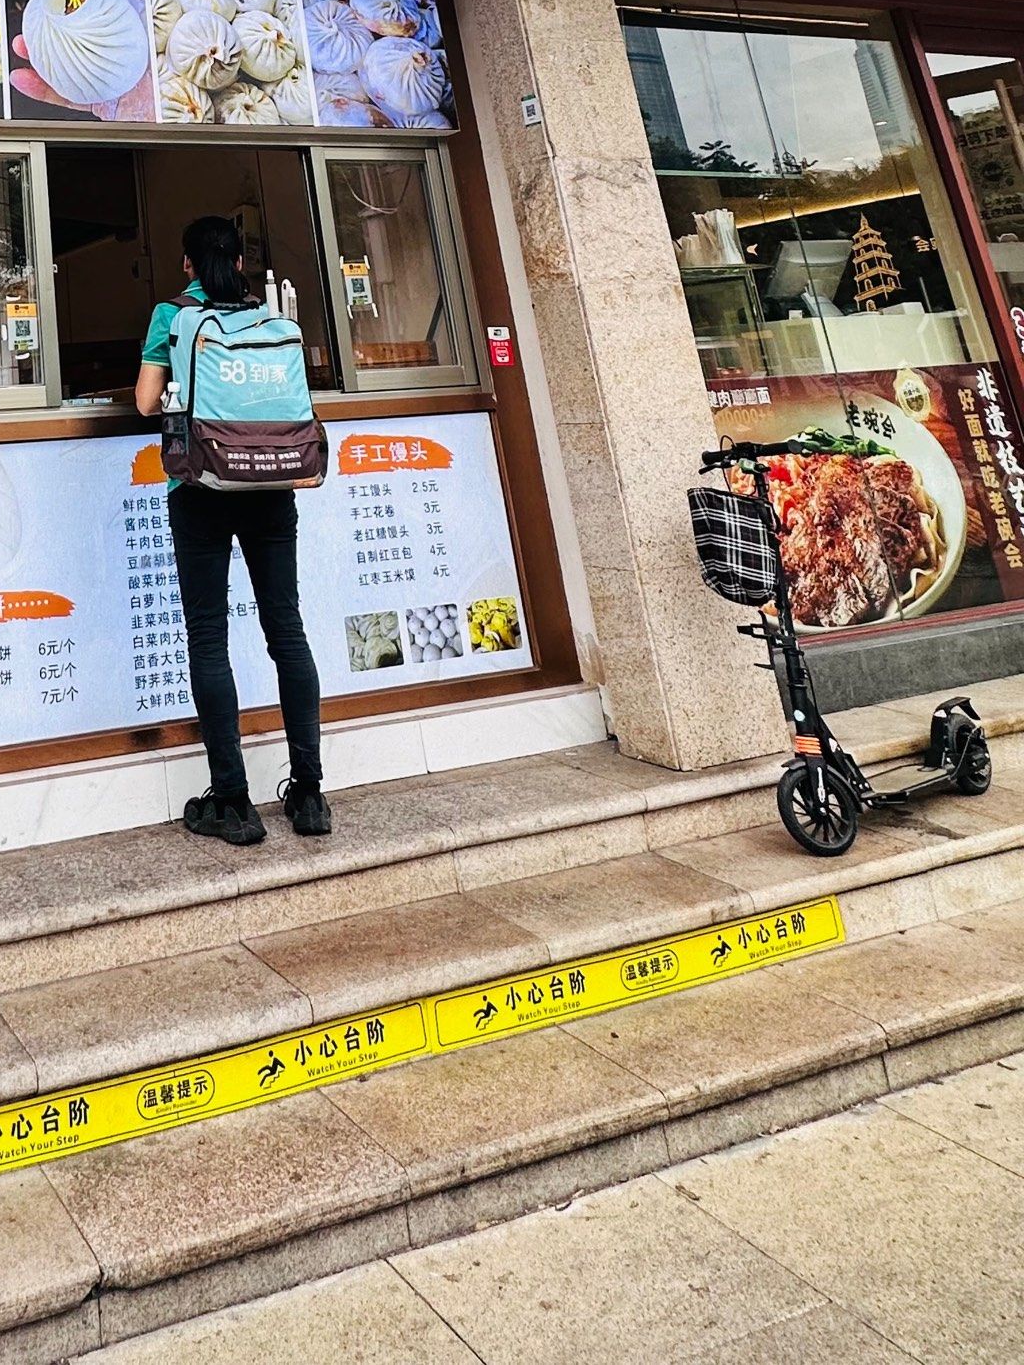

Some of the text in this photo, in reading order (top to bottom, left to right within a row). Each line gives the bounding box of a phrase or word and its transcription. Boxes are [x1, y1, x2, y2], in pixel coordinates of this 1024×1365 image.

[350, 442, 428, 465] 手工馒头
[348, 483, 392, 499] 手工馒头
[424, 501, 441, 513] 3元
[427, 522, 444, 535] 3元
[430, 543, 447, 556] 4元
[433, 565, 450, 577] 4元
[38, 638, 75, 656] 6元/个
[39, 662, 77, 680] 6元/个
[41, 686, 79, 704] 7元/个
[738, 912, 806, 950] 小心台阶
[749, 948, 770, 960] Watch
[787, 939, 803, 950] Step
[625, 954, 674, 981] 温馨提示
[505, 969, 586, 1011] 小心台阶
[517, 1000, 581, 1022] Watch Your Step
[294, 1018, 384, 1066] 小心台阶
[307, 1051, 379, 1077] Watch Your Step
[143, 1076, 209, 1109] 温馨提示
[29, 1140, 54, 1152] Your
[56, 1134, 80, 1148] Step
